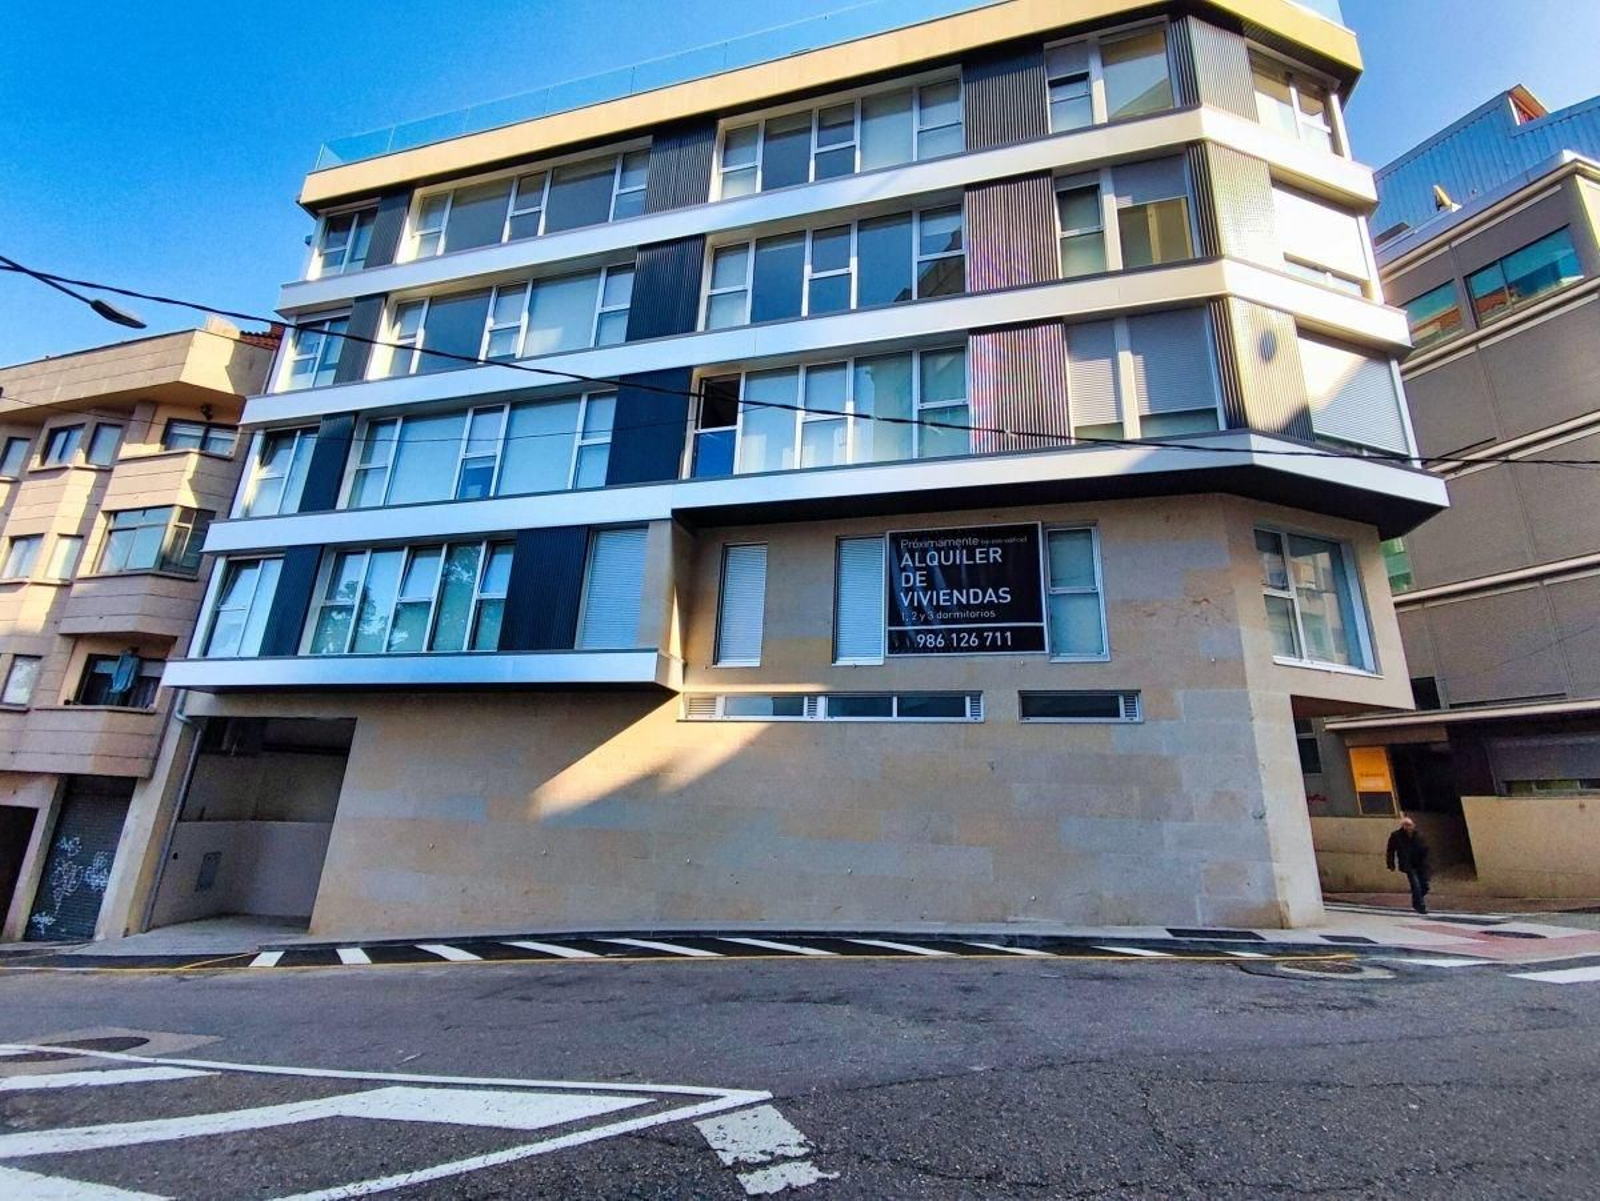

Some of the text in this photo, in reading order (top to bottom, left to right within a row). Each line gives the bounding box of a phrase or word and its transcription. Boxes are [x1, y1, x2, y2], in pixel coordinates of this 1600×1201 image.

[901, 537, 979, 549] Próximamente
[900, 547, 1002, 568] ALQUILER
[902, 571, 927, 587] DE
[900, 587, 1011, 607] VIVIENDAS
[911, 611, 917, 621] 2
[919, 613, 926, 622] y
[927, 611, 934, 620] 3
[936, 609, 996, 620] dormitorios
[916, 631, 1012, 648] 986 126 711
